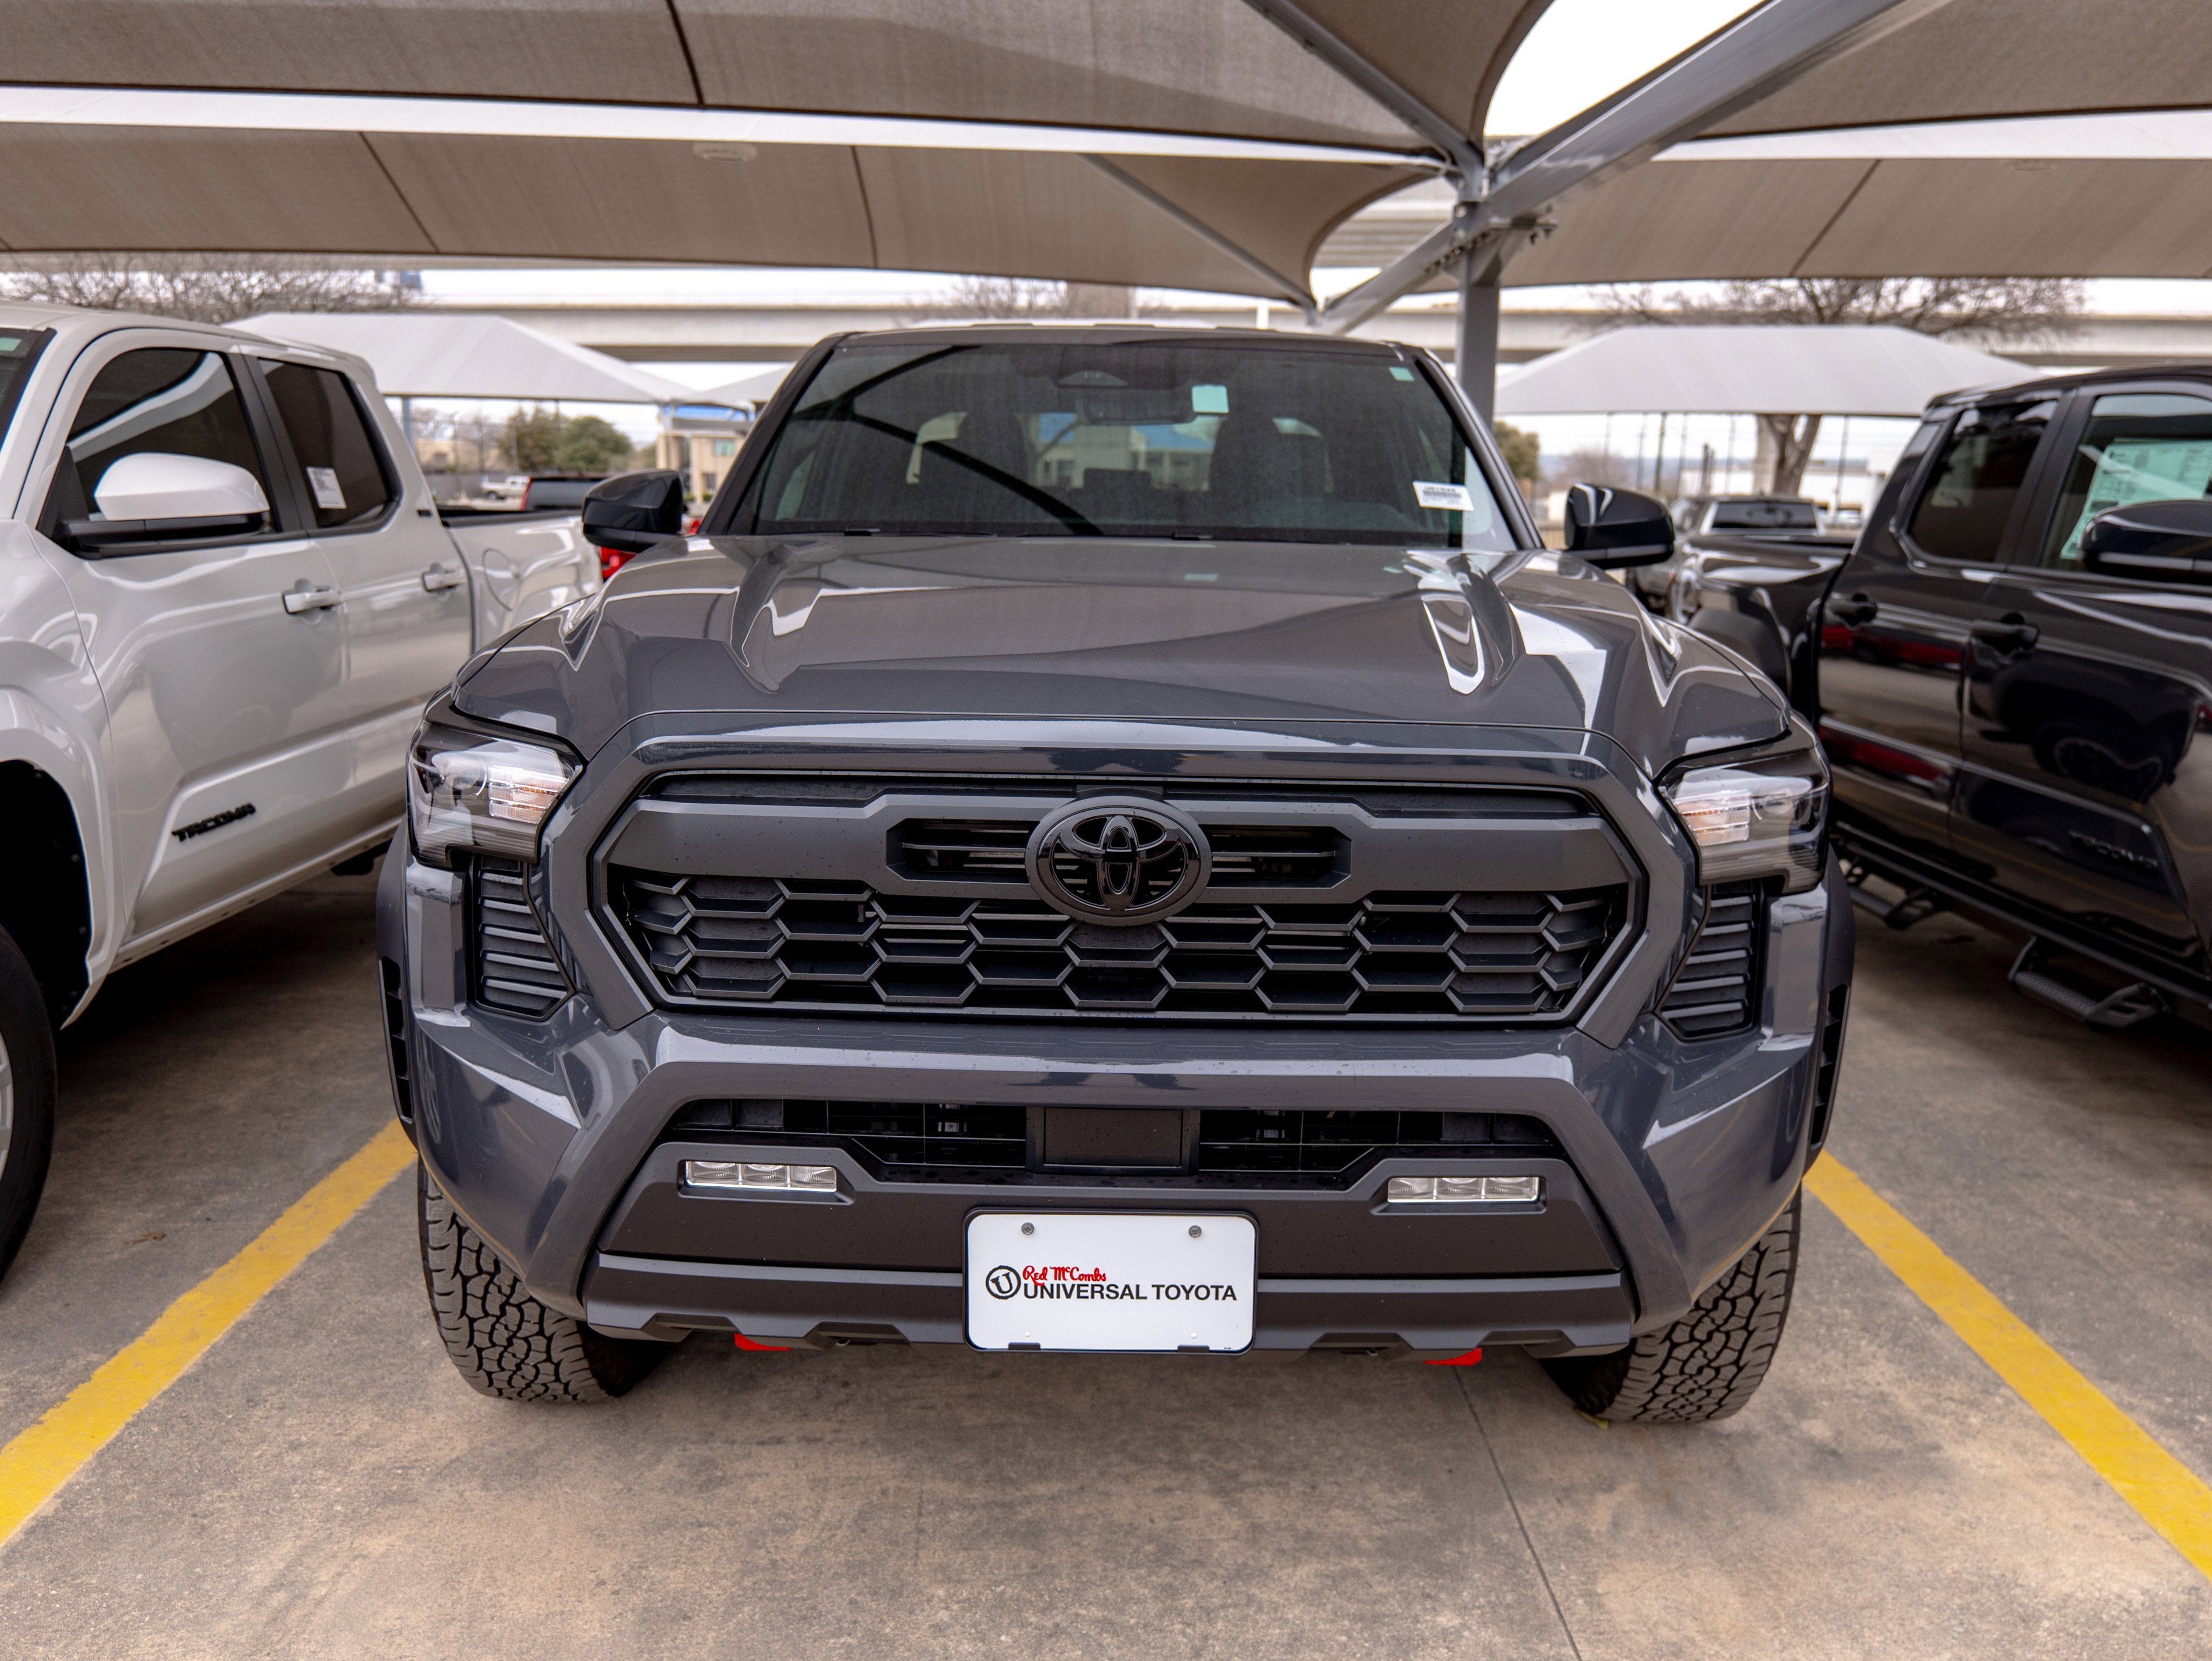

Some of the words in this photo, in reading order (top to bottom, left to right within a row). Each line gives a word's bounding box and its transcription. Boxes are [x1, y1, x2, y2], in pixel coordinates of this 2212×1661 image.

[1022, 1265, 1048, 1286] Red
[1050, 1266, 1107, 1282] McCombs
[1024, 1283, 1147, 1300] UNIVERSAL
[1152, 1284, 1237, 1301] TOYOTA
